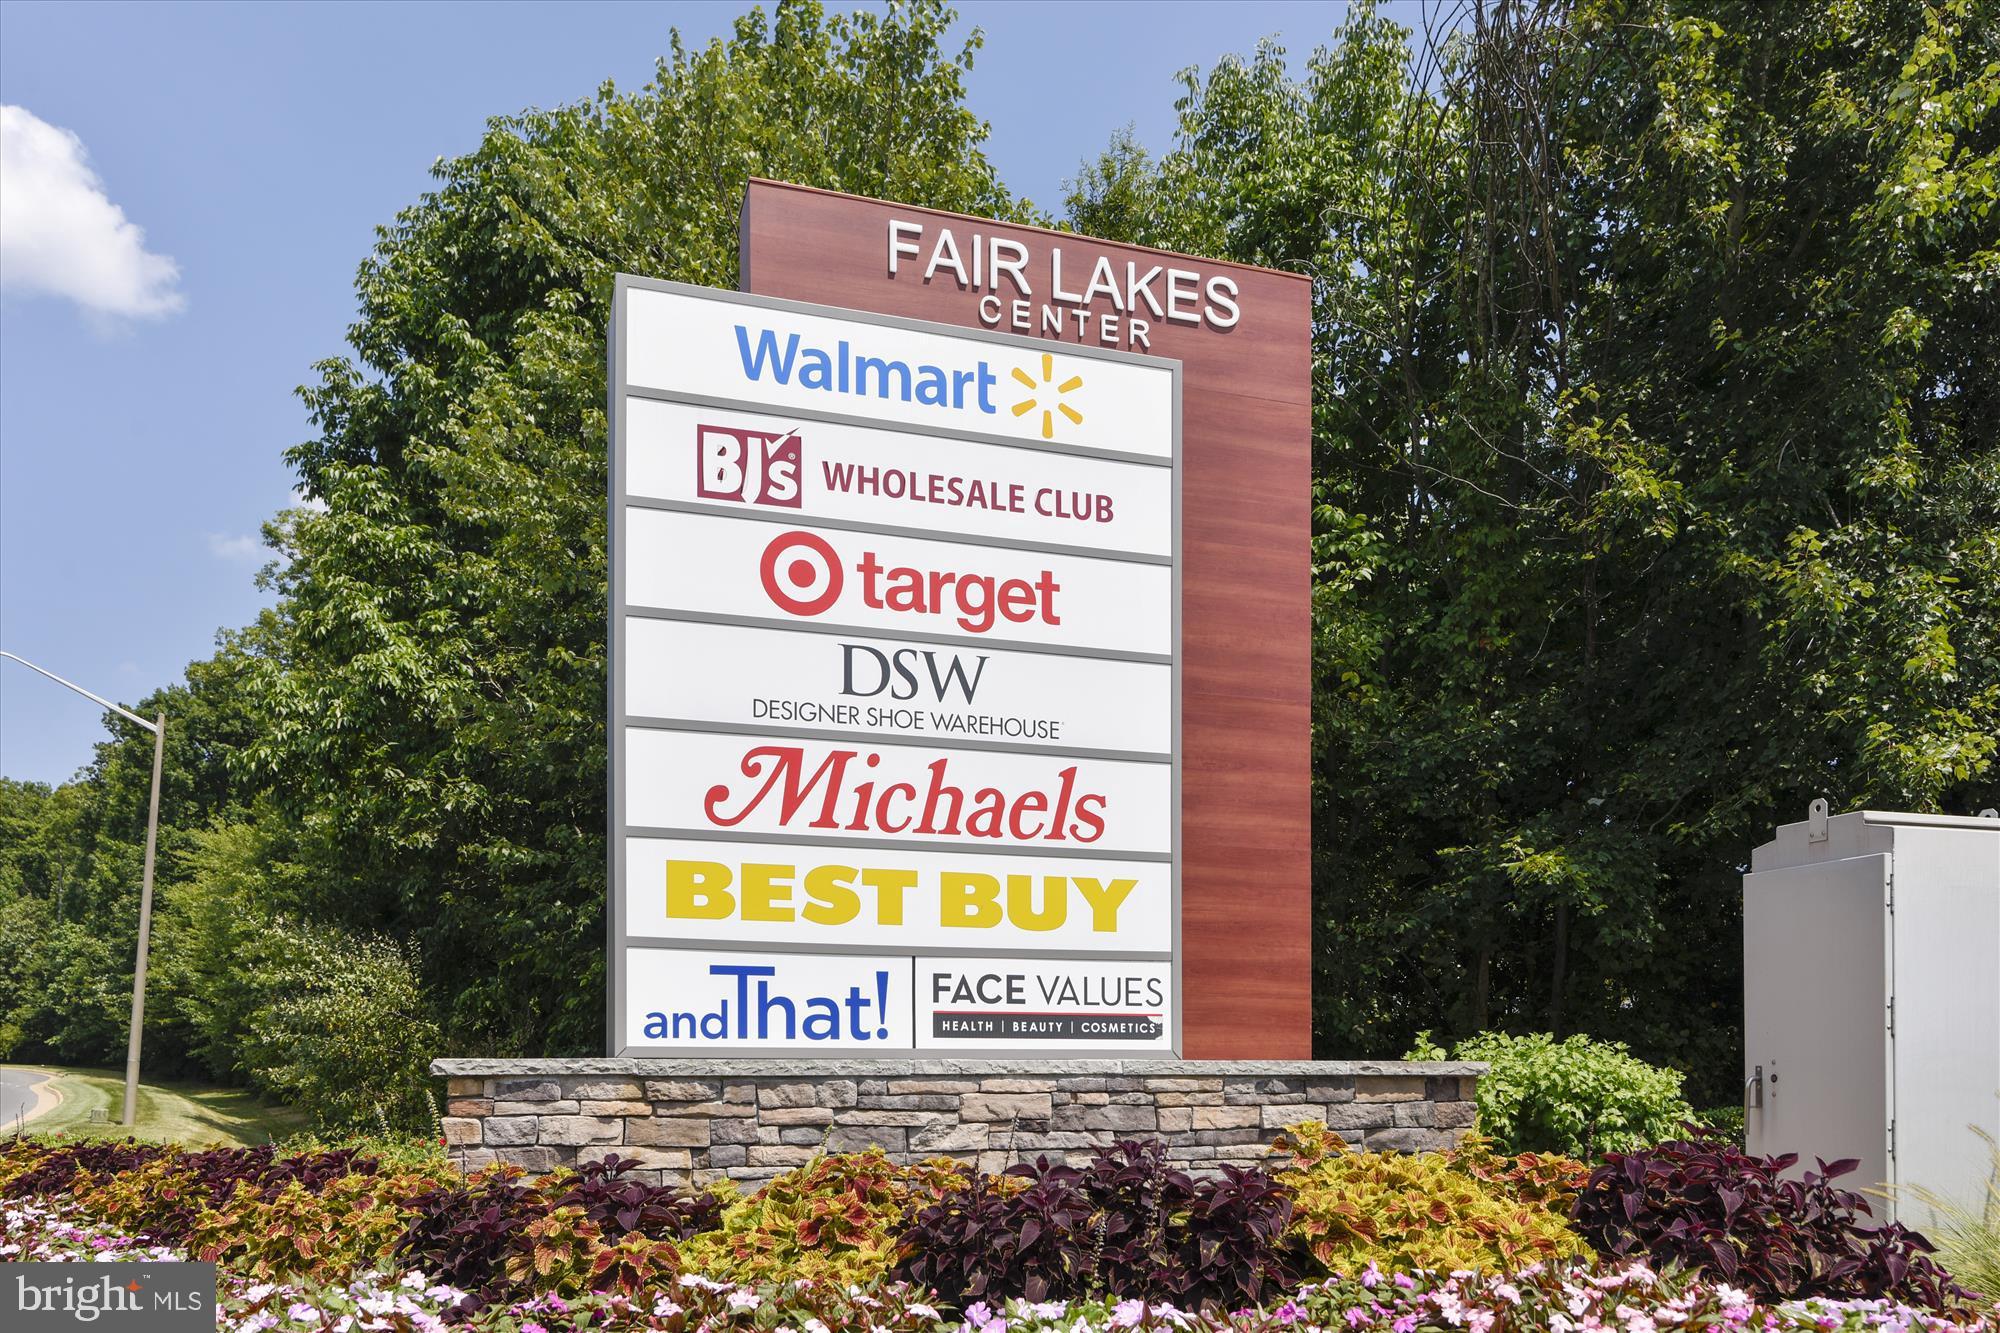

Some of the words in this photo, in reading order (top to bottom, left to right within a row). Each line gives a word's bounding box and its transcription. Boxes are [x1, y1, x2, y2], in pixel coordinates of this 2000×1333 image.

[887, 219, 1032, 296] FAIR
[1051, 248, 1240, 329] LAKES
[978, 294, 1152, 349] CENTER
[734, 324, 997, 414] Walmart
[822, 461, 1025, 513] WHOLESALE
[1034, 487, 1114, 523] CLUB
[856, 551, 1061, 633] target
[838, 643, 990, 705] DSW
[752, 698, 860, 727] DESIGNER
[866, 704, 924, 731] SHOE
[930, 710, 1060, 740] WAREHOUSE
[703, 746, 1107, 843] Michaels
[665, 859, 918, 926] BEST
[939, 871, 1139, 933] BUY
[932, 972, 1026, 1005] FACE
[1037, 974, 1164, 1008] VALUES
[941, 1017, 994, 1034] HEALTH
[1012, 1018, 1063, 1034] BEAUTY
[1080, 1019, 1158, 1034] COSMETICS
